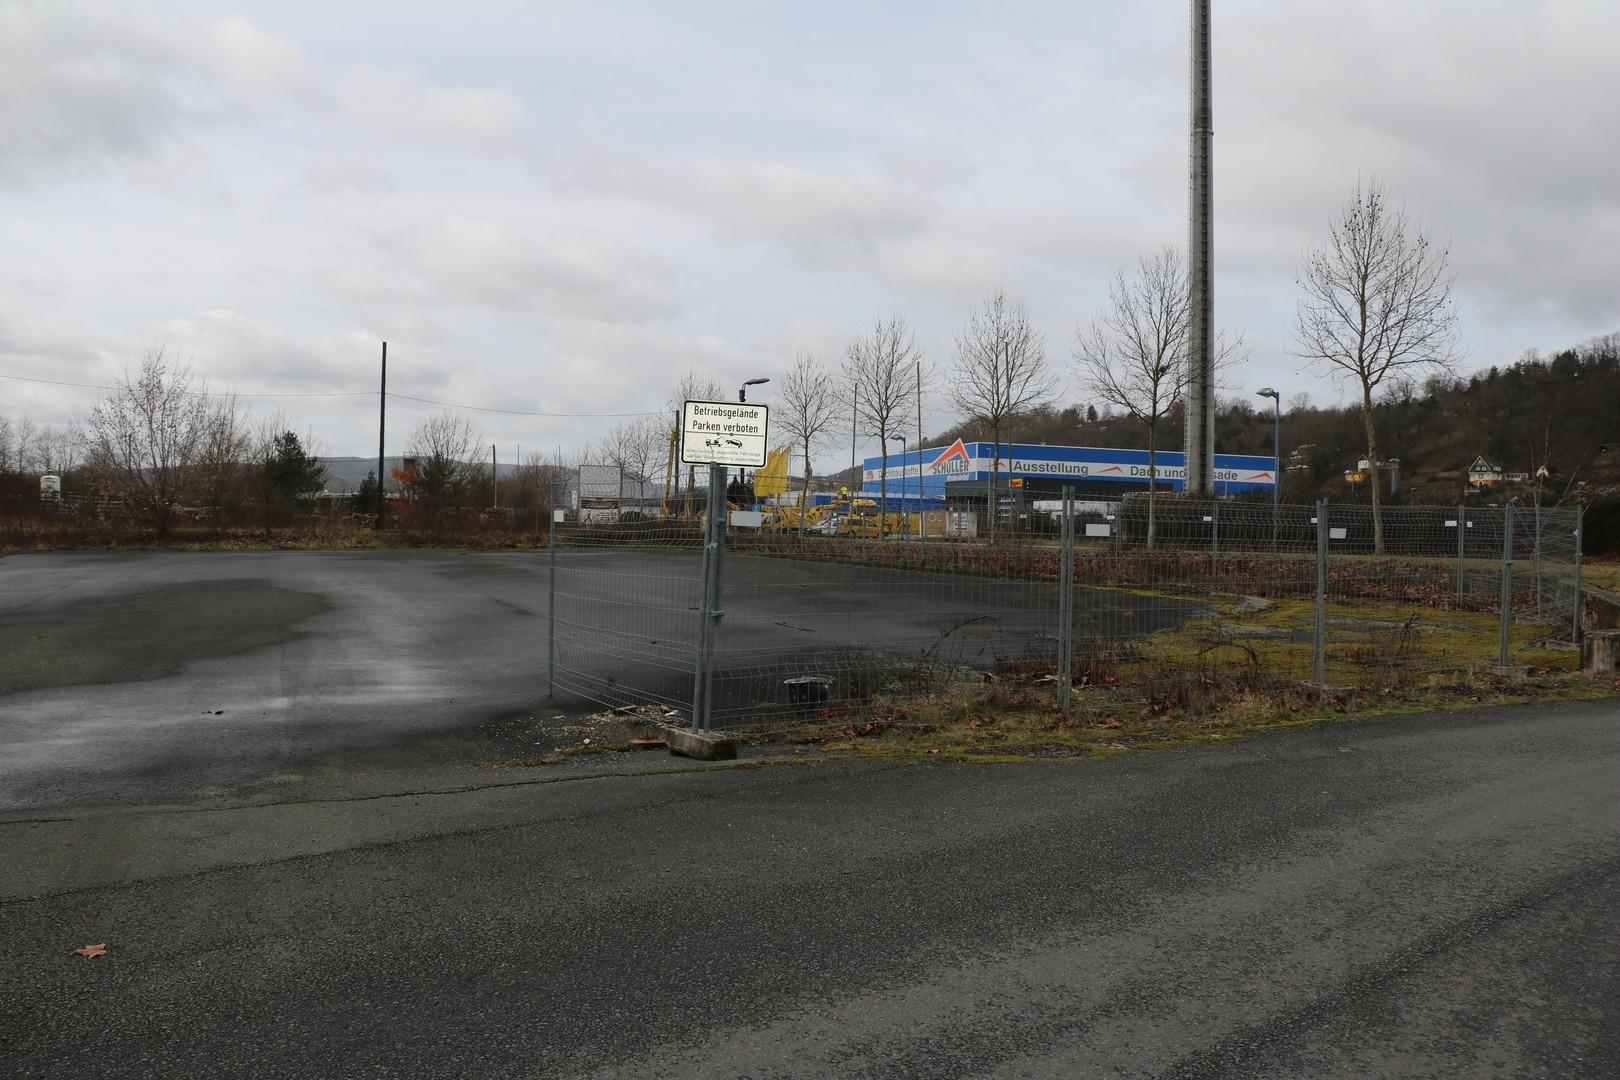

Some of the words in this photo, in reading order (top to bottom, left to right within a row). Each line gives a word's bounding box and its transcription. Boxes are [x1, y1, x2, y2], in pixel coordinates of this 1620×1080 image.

[694, 405, 759, 419] Betriebsgelände
[692, 420, 721, 431] Parken
[723, 422, 759, 433] verboten
[878, 466, 919, 479] Dchbautoffe
[933, 459, 970, 474] SCHÜLLER
[1013, 461, 1089, 477] Ausstellung
